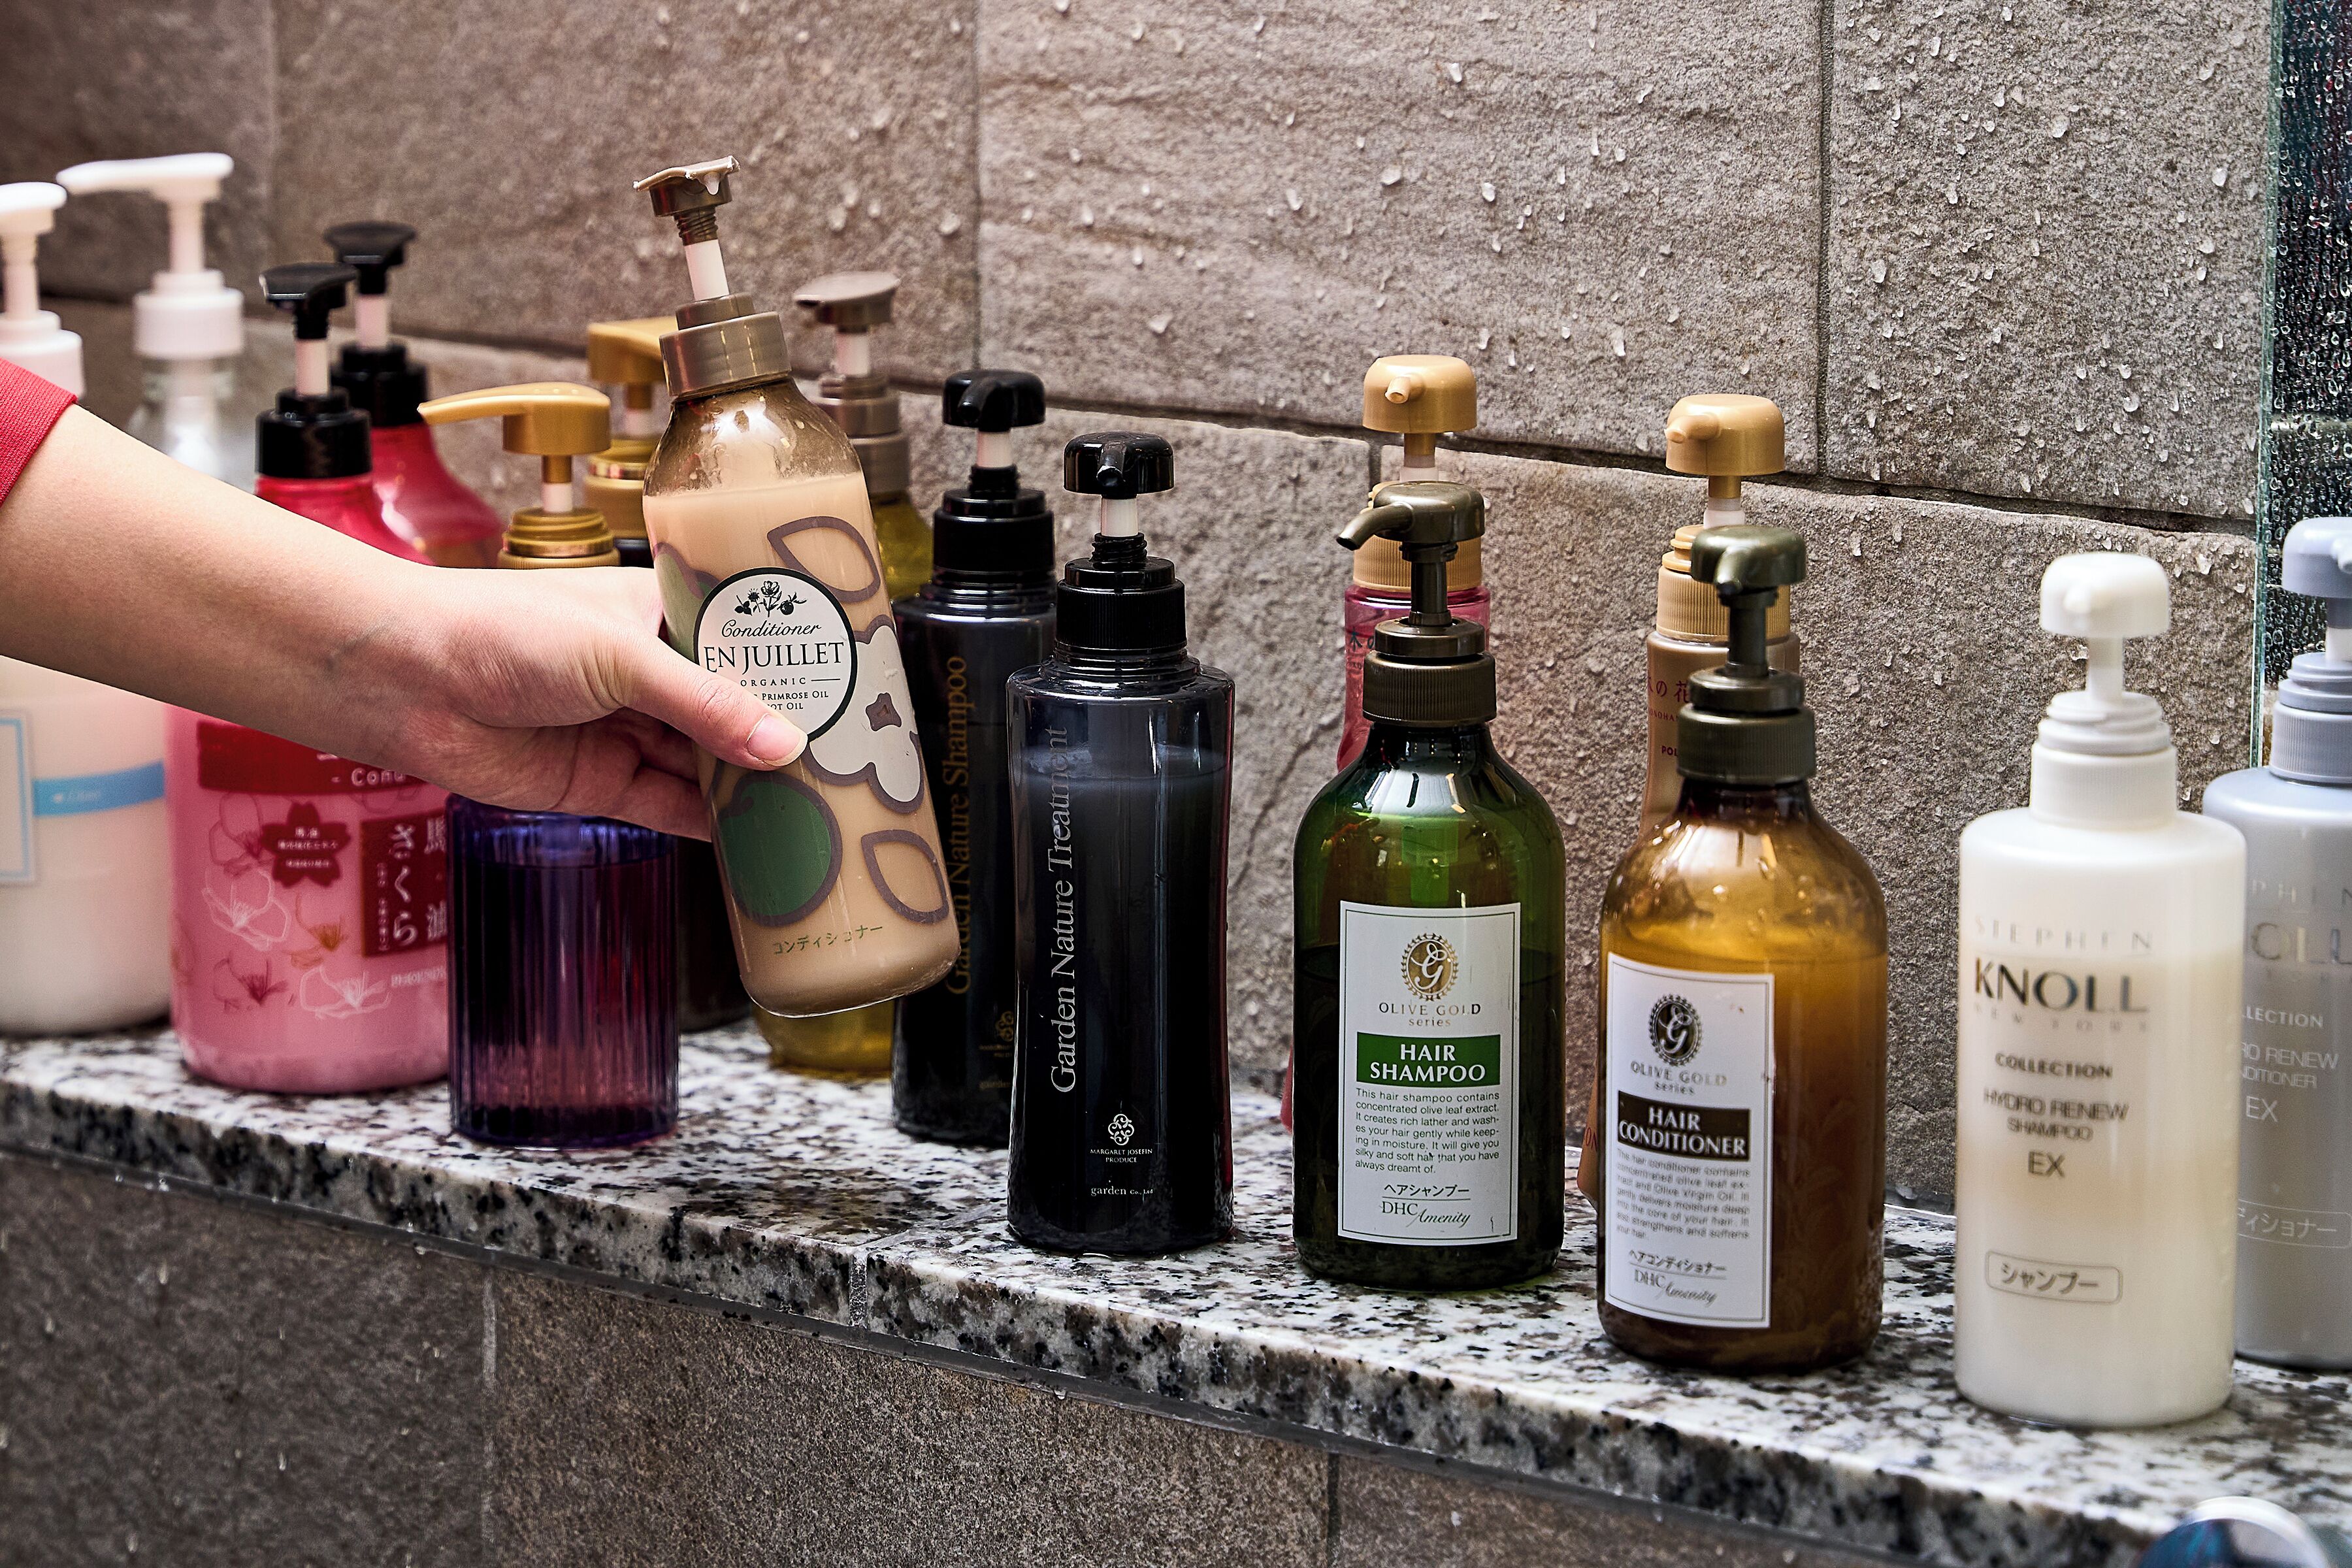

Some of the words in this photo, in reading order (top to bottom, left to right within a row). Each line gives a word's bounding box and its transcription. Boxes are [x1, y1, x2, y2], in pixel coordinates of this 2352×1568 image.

[722, 619, 821, 637] Conditioner
[704, 646, 736, 673] EN
[742, 642, 844, 675] JUILLET
[740, 677, 806, 686] ORGANIC
[943, 655, 975, 786] Shampoo
[1661, 745, 1678, 757] POL
[1045, 726, 1072, 872] Treatment
[949, 790, 970, 891] Nature
[772, 924, 883, 955] コンディショナー
[1051, 880, 1075, 979] Nature
[1976, 957, 2148, 1012] KNOLL
[1379, 1002, 1428, 1015] OLIVE
[1437, 1004, 1481, 1015] GOLD
[2242, 1006, 2323, 1028] LECTION
[1409, 1017, 1451, 1026] series
[1051, 985, 1076, 1093] Garden
[1401, 1044, 1456, 1061] HAIR
[1370, 1062, 1485, 1082] SHAMPOO
[1631, 1061, 1673, 1081] OLIVE
[1679, 1070, 1727, 1086] GOLD
[1995, 1053, 2113, 1079] COLLECTION
[2242, 1065, 2317, 1088] DITIONER
[1356, 1088, 1376, 1099] This
[1380, 1091, 1398, 1100] hair
[1403, 1094, 1452, 1103] shampoo
[1457, 1092, 1499, 1102] contains
[1656, 1082, 1695, 1096] series
[1356, 1102, 1417, 1113] concentrated
[1465, 1103, 1499, 1113] extract.
[2050, 1099, 2130, 1122] RENEW
[2246, 1096, 2278, 1122] EX
[1364, 1114, 1397, 1124] creates
[1401, 1117, 1418, 1125] rich
[1421, 1118, 1448, 1126] lather
[1452, 1117, 1469, 1126] and
[1649, 1107, 1701, 1132] HAIR
[1356, 1135, 1369, 1147] ing
[1461, 1141, 1480, 1151] give
[1483, 1140, 1499, 1149] you
[1369, 1126, 1388, 1135] your
[1392, 1128, 1409, 1137] hair
[1413, 1130, 1443, 1139] gently
[1446, 1129, 1470, 1137] while
[1619, 1120, 1746, 1156] CONDITIONER
[1355, 1160, 1384, 1171] always
[1388, 1164, 1420, 1173] dreamt
[1356, 1149, 1374, 1158] silky
[1377, 1151, 1394, 1159] and
[1396, 1152, 1414, 1160] soft
[1417, 1152, 1435, 1162] hair
[1438, 1154, 1456, 1163] that
[1459, 1153, 1475, 1163] you
[2028, 1151, 2065, 1178] EX
[1091, 1186, 1126, 1196] garden
[1384, 1184, 1469, 1197] ヘアシャンプー
[1382, 1201, 1418, 1216] DHC
[1406, 1209, 1471, 1228] Amenity
[1629, 1249, 1727, 1274] ヘアコンディショナー
[1635, 1269, 1666, 1288] DHC
[2002, 1263, 2099, 1295] シャンプー
